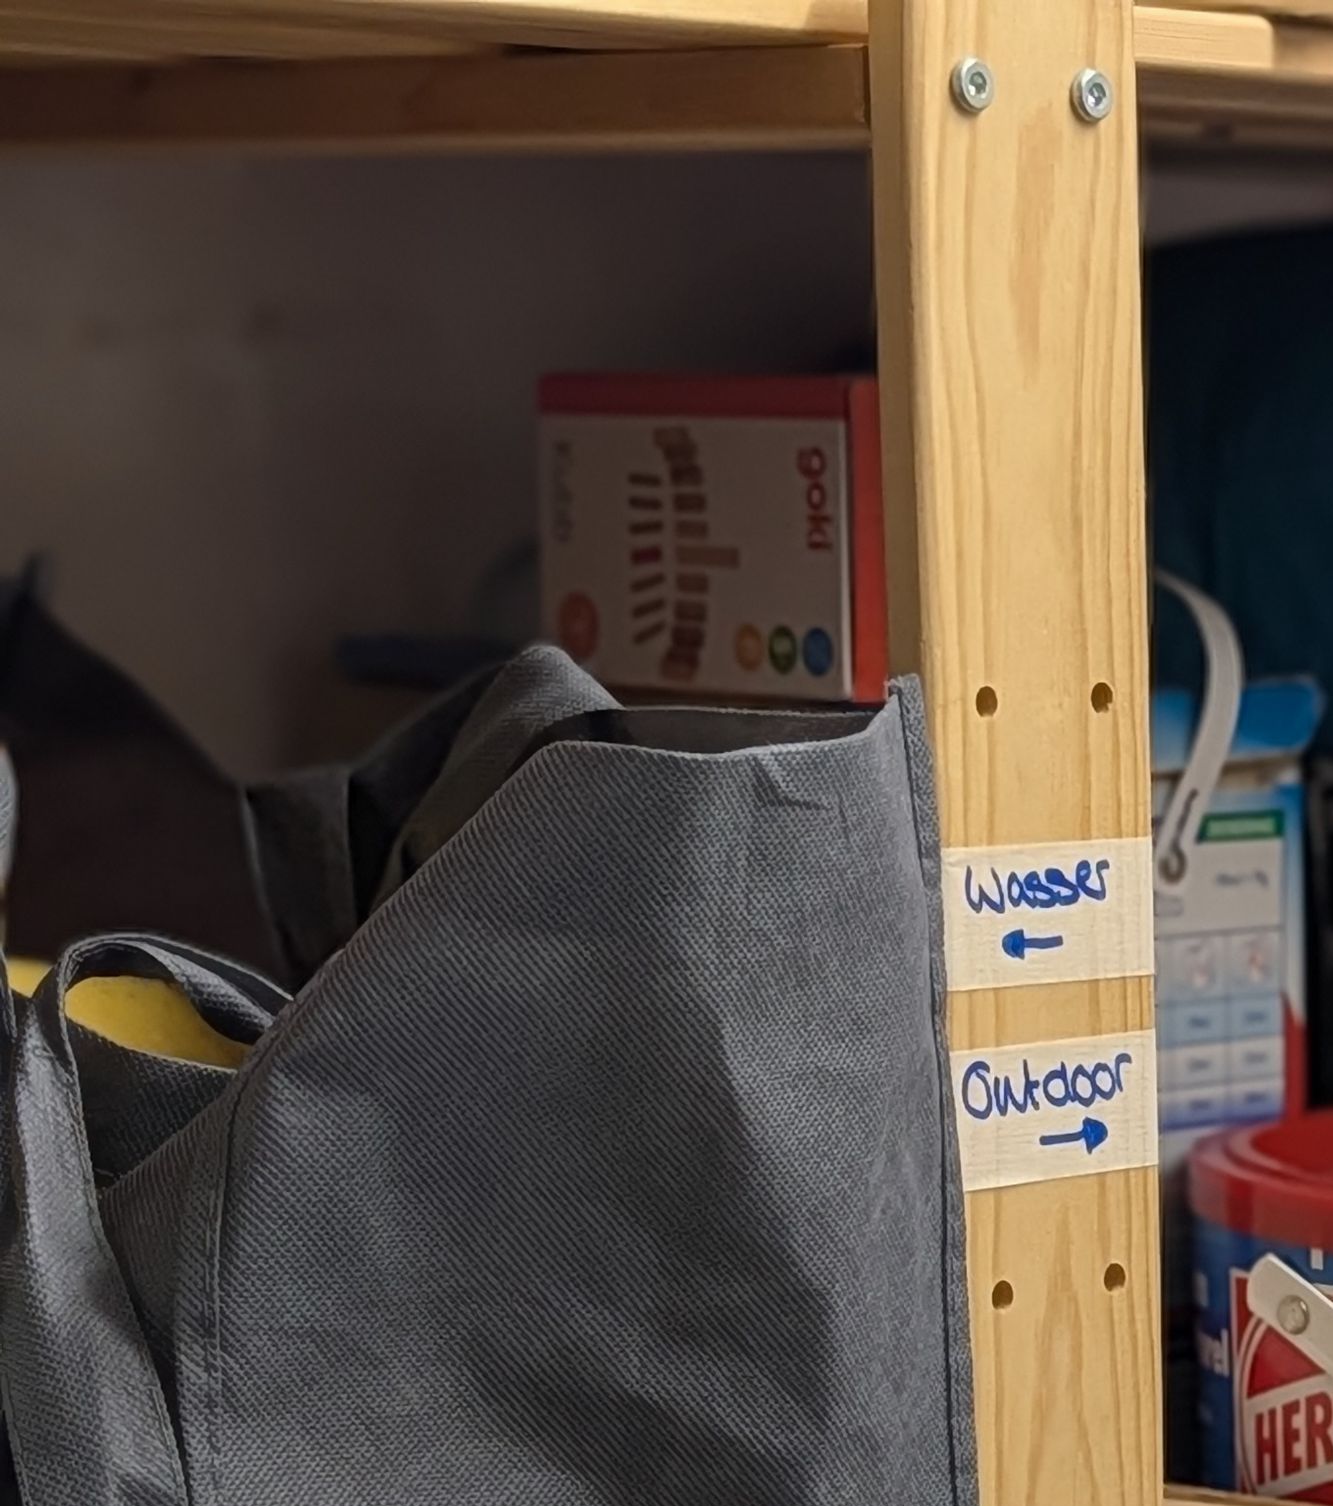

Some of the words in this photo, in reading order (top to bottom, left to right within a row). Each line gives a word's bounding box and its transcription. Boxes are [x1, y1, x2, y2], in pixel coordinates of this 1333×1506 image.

[797, 448, 832, 551] goki
[965, 859, 1110, 913] Wasser
[962, 1052, 1132, 1119] Outdoor
